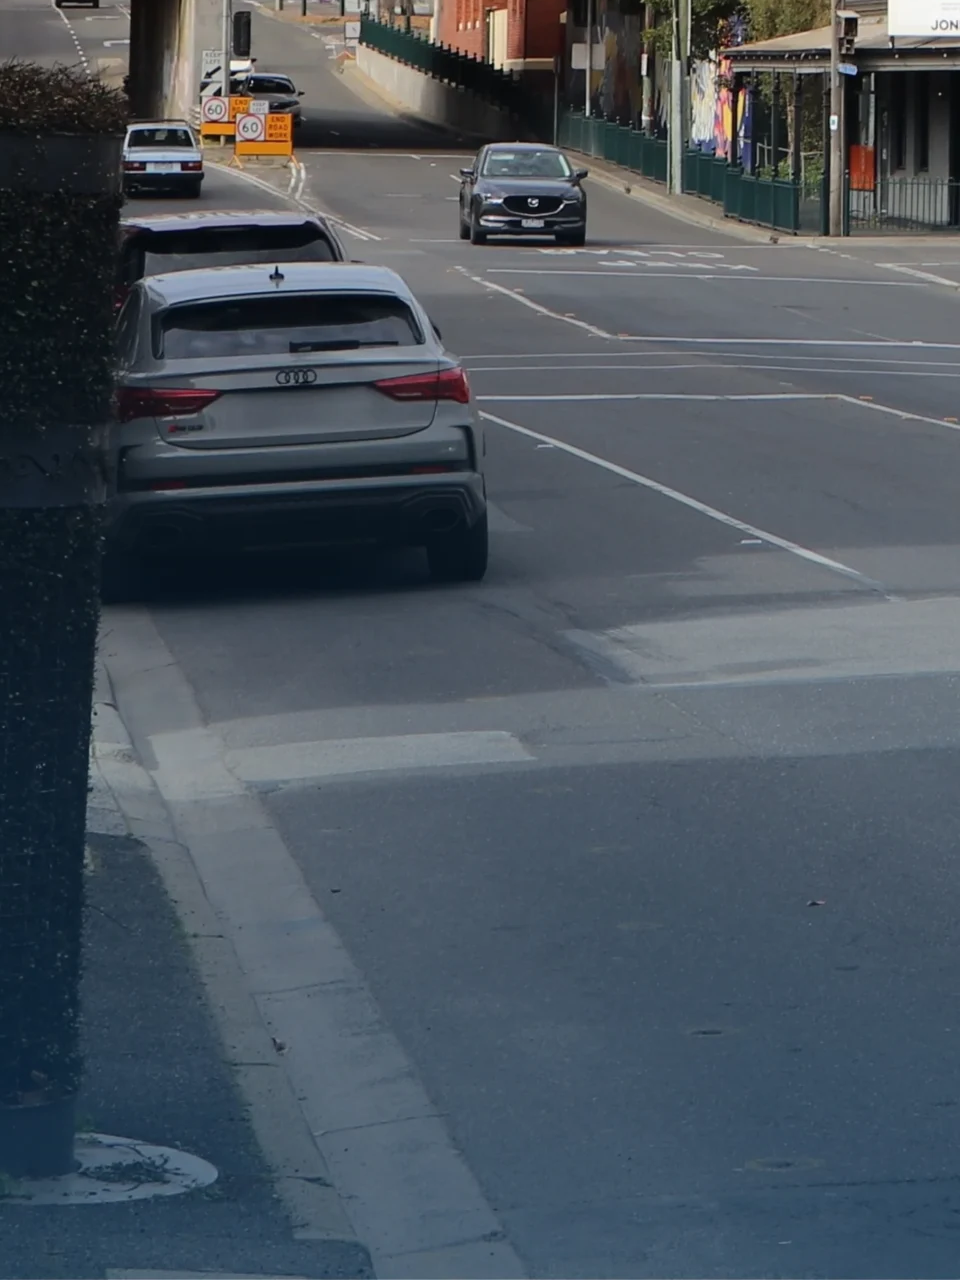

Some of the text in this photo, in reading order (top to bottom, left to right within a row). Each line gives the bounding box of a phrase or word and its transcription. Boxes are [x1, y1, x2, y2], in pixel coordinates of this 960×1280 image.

[931, 20, 960, 31] JON
[208, 105, 222, 115] 60
[242, 122, 258, 132] 60
